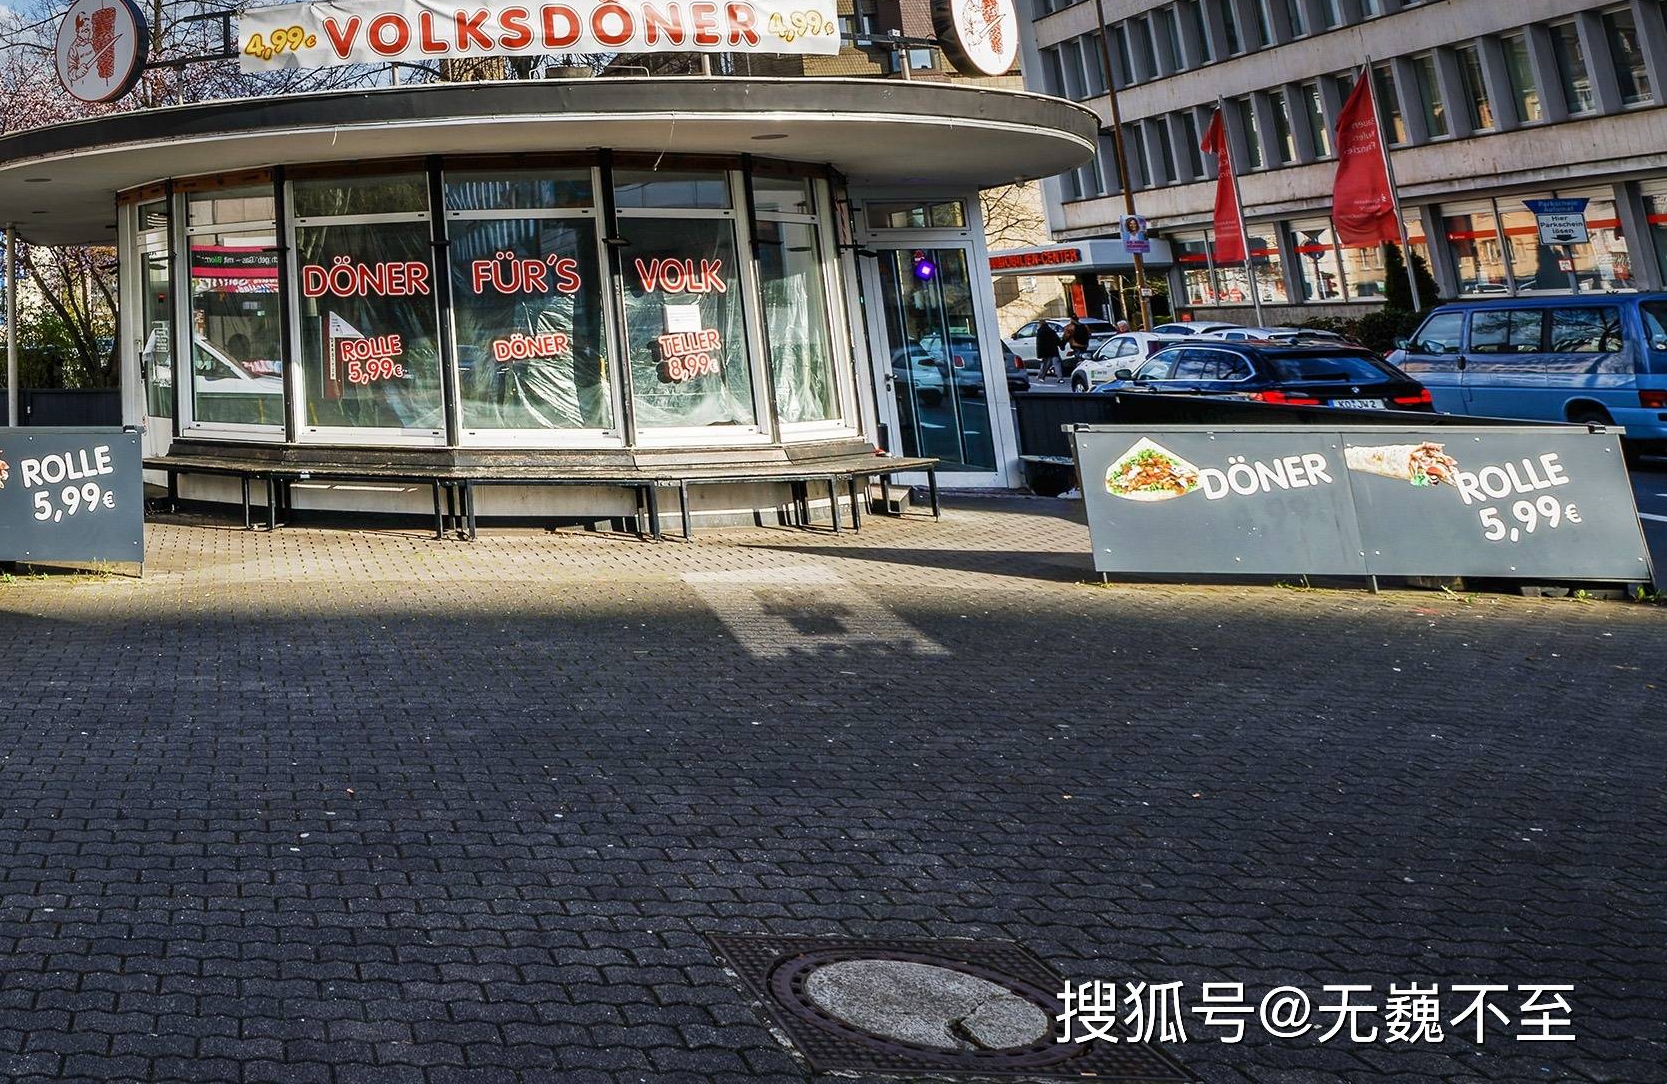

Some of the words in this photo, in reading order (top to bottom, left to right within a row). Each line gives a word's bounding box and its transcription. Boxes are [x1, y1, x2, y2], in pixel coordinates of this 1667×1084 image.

[244, 24, 317, 61] 4,99€
[302, 256, 430, 298] DÖNER
[472, 251, 582, 294] FÜR'S
[634, 257, 727, 294] VOLK
[340, 334, 403, 362] ROLLE
[492, 332, 570, 362] DÖNER
[658, 328, 722, 358] TELLER
[348, 356, 405, 385] 5,99€
[20, 445, 114, 489] ROLLE
[1199, 455, 1333, 501] DÖNER
[1454, 452, 1570, 505] ROLLE
[34, 482, 116, 523] 5,99€
[1478, 495, 1583, 543] 5,99€
